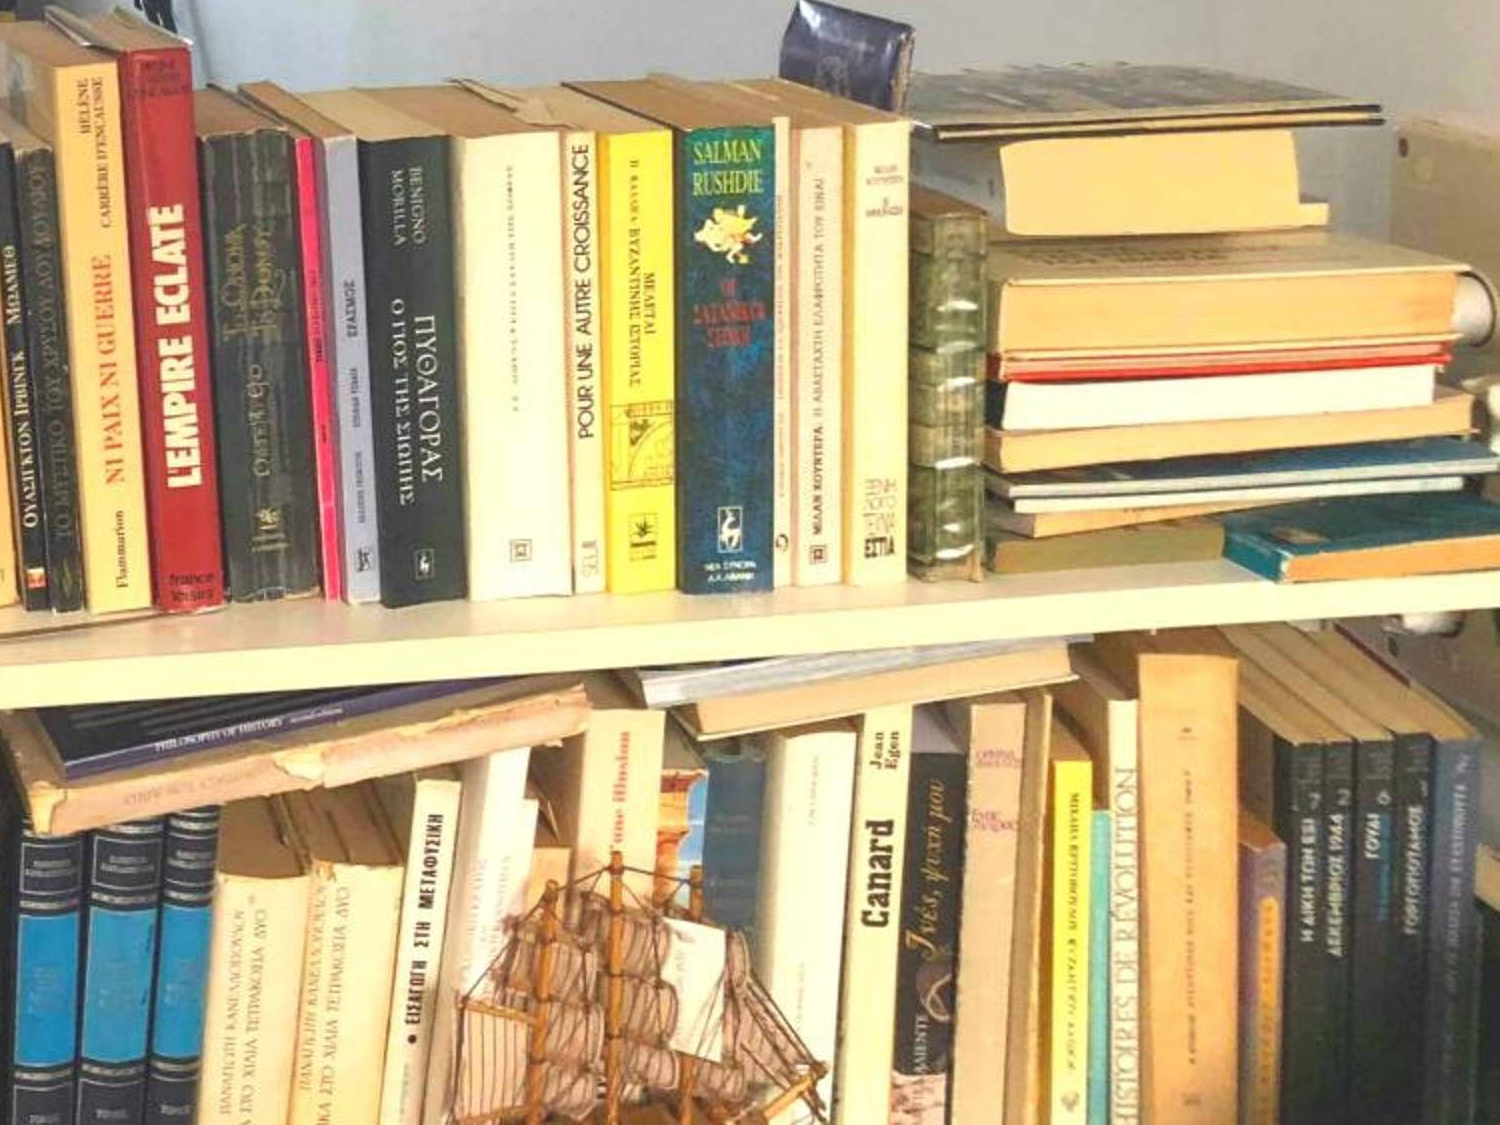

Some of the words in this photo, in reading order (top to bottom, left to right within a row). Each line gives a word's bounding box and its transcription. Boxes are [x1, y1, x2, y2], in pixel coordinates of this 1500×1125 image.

[692, 138, 764, 166] SALMAN
[408, 166, 428, 245] BENIGNO
[692, 168, 765, 197] RUSHDIE
[390, 170, 408, 246] MORILLA
[570, 143, 592, 274] CROISSANCE
[2, 245, 22, 325] ΜΩΑΜΕΘ
[147, 203, 191, 326] ECLATE
[628, 227, 642, 321] ΒΥΖΑΝΤΙΝΗΣ
[90, 254, 118, 356] GUERRE
[390, 298, 406, 316] Ο
[573, 278, 593, 337] AUTRE
[391, 321, 409, 370] ΓΙΟΣ
[574, 343, 594, 382] UNE
[97, 361, 118, 387] NI
[394, 372, 412, 419] ΤΗΣ
[100, 393, 124, 451] PAIX
[157, 335, 201, 488] L'EMPIRE
[413, 315, 444, 484] ΠΥΘΑΓΟΡΑΣ
[576, 385, 596, 440] POUR
[104, 458, 127, 485] NI
[396, 422, 417, 507] ΣΙΩΠΗΣ
[110, 510, 131, 589] Flammarion
[155, 728, 223, 753] PHILOSOPHY
[221, 724, 238, 740] OF
[238, 716, 283, 735] HISTORY
[868, 731, 884, 771] Jean
[883, 730, 901, 771] Egen
[924, 778, 953, 823] μου
[920, 825, 949, 882] ψυχή
[1328, 813, 1345, 852] 1944
[1364, 812, 1381, 859] ΓΟΥΔΙ
[416, 813, 444, 911] ΜΕΤΑΦΥΣΙΚΗ
[859, 819, 894, 928] Canard
[1301, 847, 1317, 884] ΤΩΝ
[1403, 804, 1423, 935] ΓΟΡΓΟΠΟΤΑΜΟΣ
[253, 908, 269, 940] ΔΥΟ
[332, 886, 351, 920] ΔΥΟ
[1300, 887, 1316, 927] ΔΙΚΗ
[1326, 854, 1345, 958] ΔΕΚΕΜΒΡΙΟΣ
[411, 921, 432, 949] ΣΤΗ
[1300, 928, 1314, 942] Η
[246, 945, 266, 1034] ΤΕΤΡΑΚΟΣΙΑ
[1113, 951, 1140, 985] DE
[403, 960, 428, 1026] ΕΙΣΑΓΩΓΗ
[242, 1038, 262, 1079] ΧΙΛΙΑ
[322, 1017, 343, 1059] ΧΙΛΙΑ
[1112, 996, 1140, 1125] HISTOIRES
[218, 1035, 239, 1116] ΠΑΝΑΓΙΩΤΗ
[240, 1083, 256, 1114] ΣΤΟ
[319, 1064, 337, 1096] ΣΤΟ
